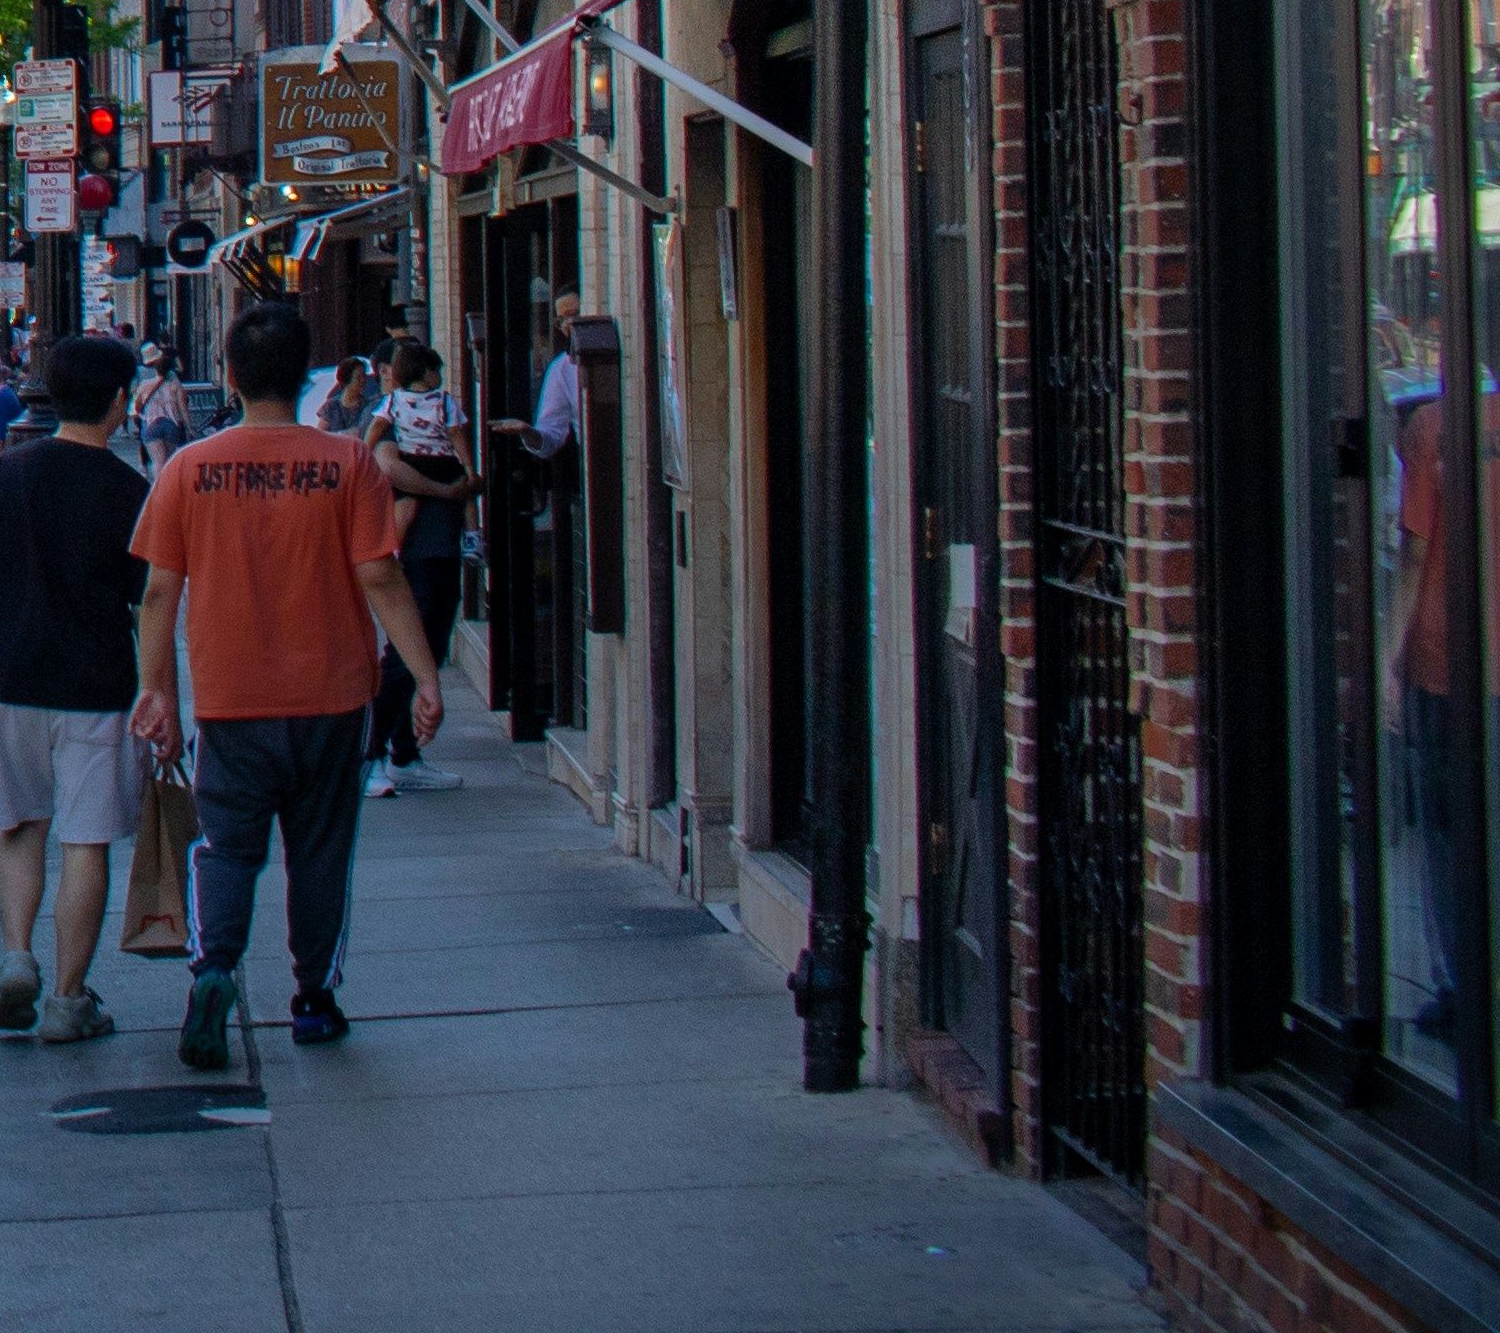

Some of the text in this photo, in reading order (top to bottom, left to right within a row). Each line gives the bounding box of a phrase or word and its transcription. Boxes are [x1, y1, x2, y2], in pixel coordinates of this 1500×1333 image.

[276, 75, 387, 100] Trattoria
[278, 102, 301, 129] Il
[29, 162, 71, 172] TOW ZONE
[40, 177, 58, 187] NO
[28, 188, 71, 196] STOPPING
[40, 197, 57, 205] ANY
[39, 206, 59, 214] TIME
[194, 462, 234, 493] JUST
[289, 460, 342, 497] AHEAD
